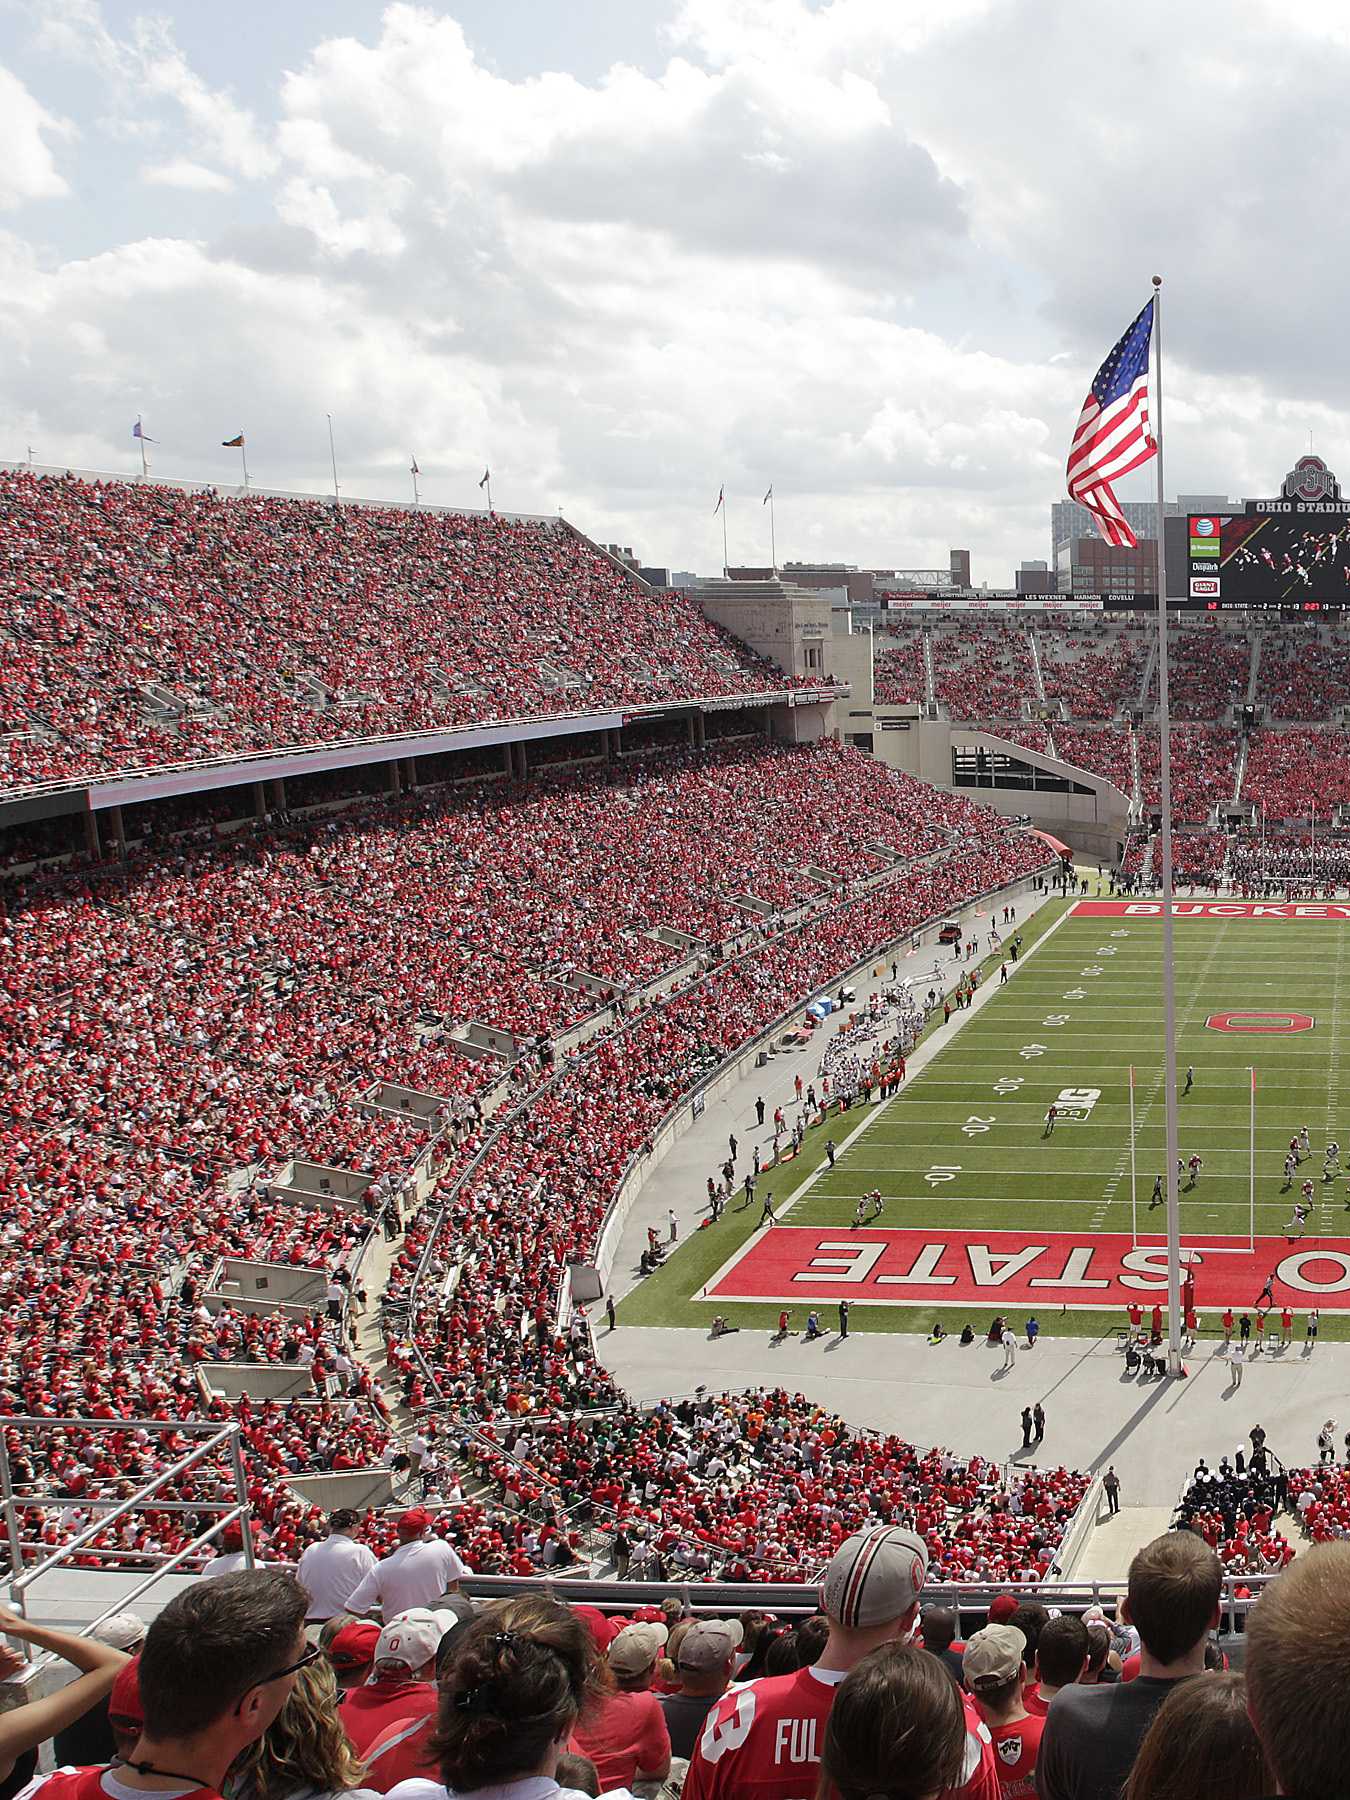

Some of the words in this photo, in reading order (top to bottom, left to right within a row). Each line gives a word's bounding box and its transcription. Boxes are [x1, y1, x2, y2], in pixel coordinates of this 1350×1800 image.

[1256, 502, 1291, 513] OHIO
[893, 601, 913, 609] meijer
[931, 601, 951, 609] meijer
[968, 601, 988, 609] meijer
[1006, 601, 1026, 609] meijer
[1043, 601, 1063, 609] meijer
[1079, 601, 1099, 609] meijer
[1042, 1014, 1071, 1026] 50
[1204, 1012, 1316, 1035] O
[1019, 1044, 1047, 1056] 40
[993, 1077, 1025, 1091] 30
[961, 1116, 996, 1133] 20
[924, 1165, 963, 1181] 10
[791, 1240, 1203, 1291] STATE
[701, 1690, 756, 1764] 3
